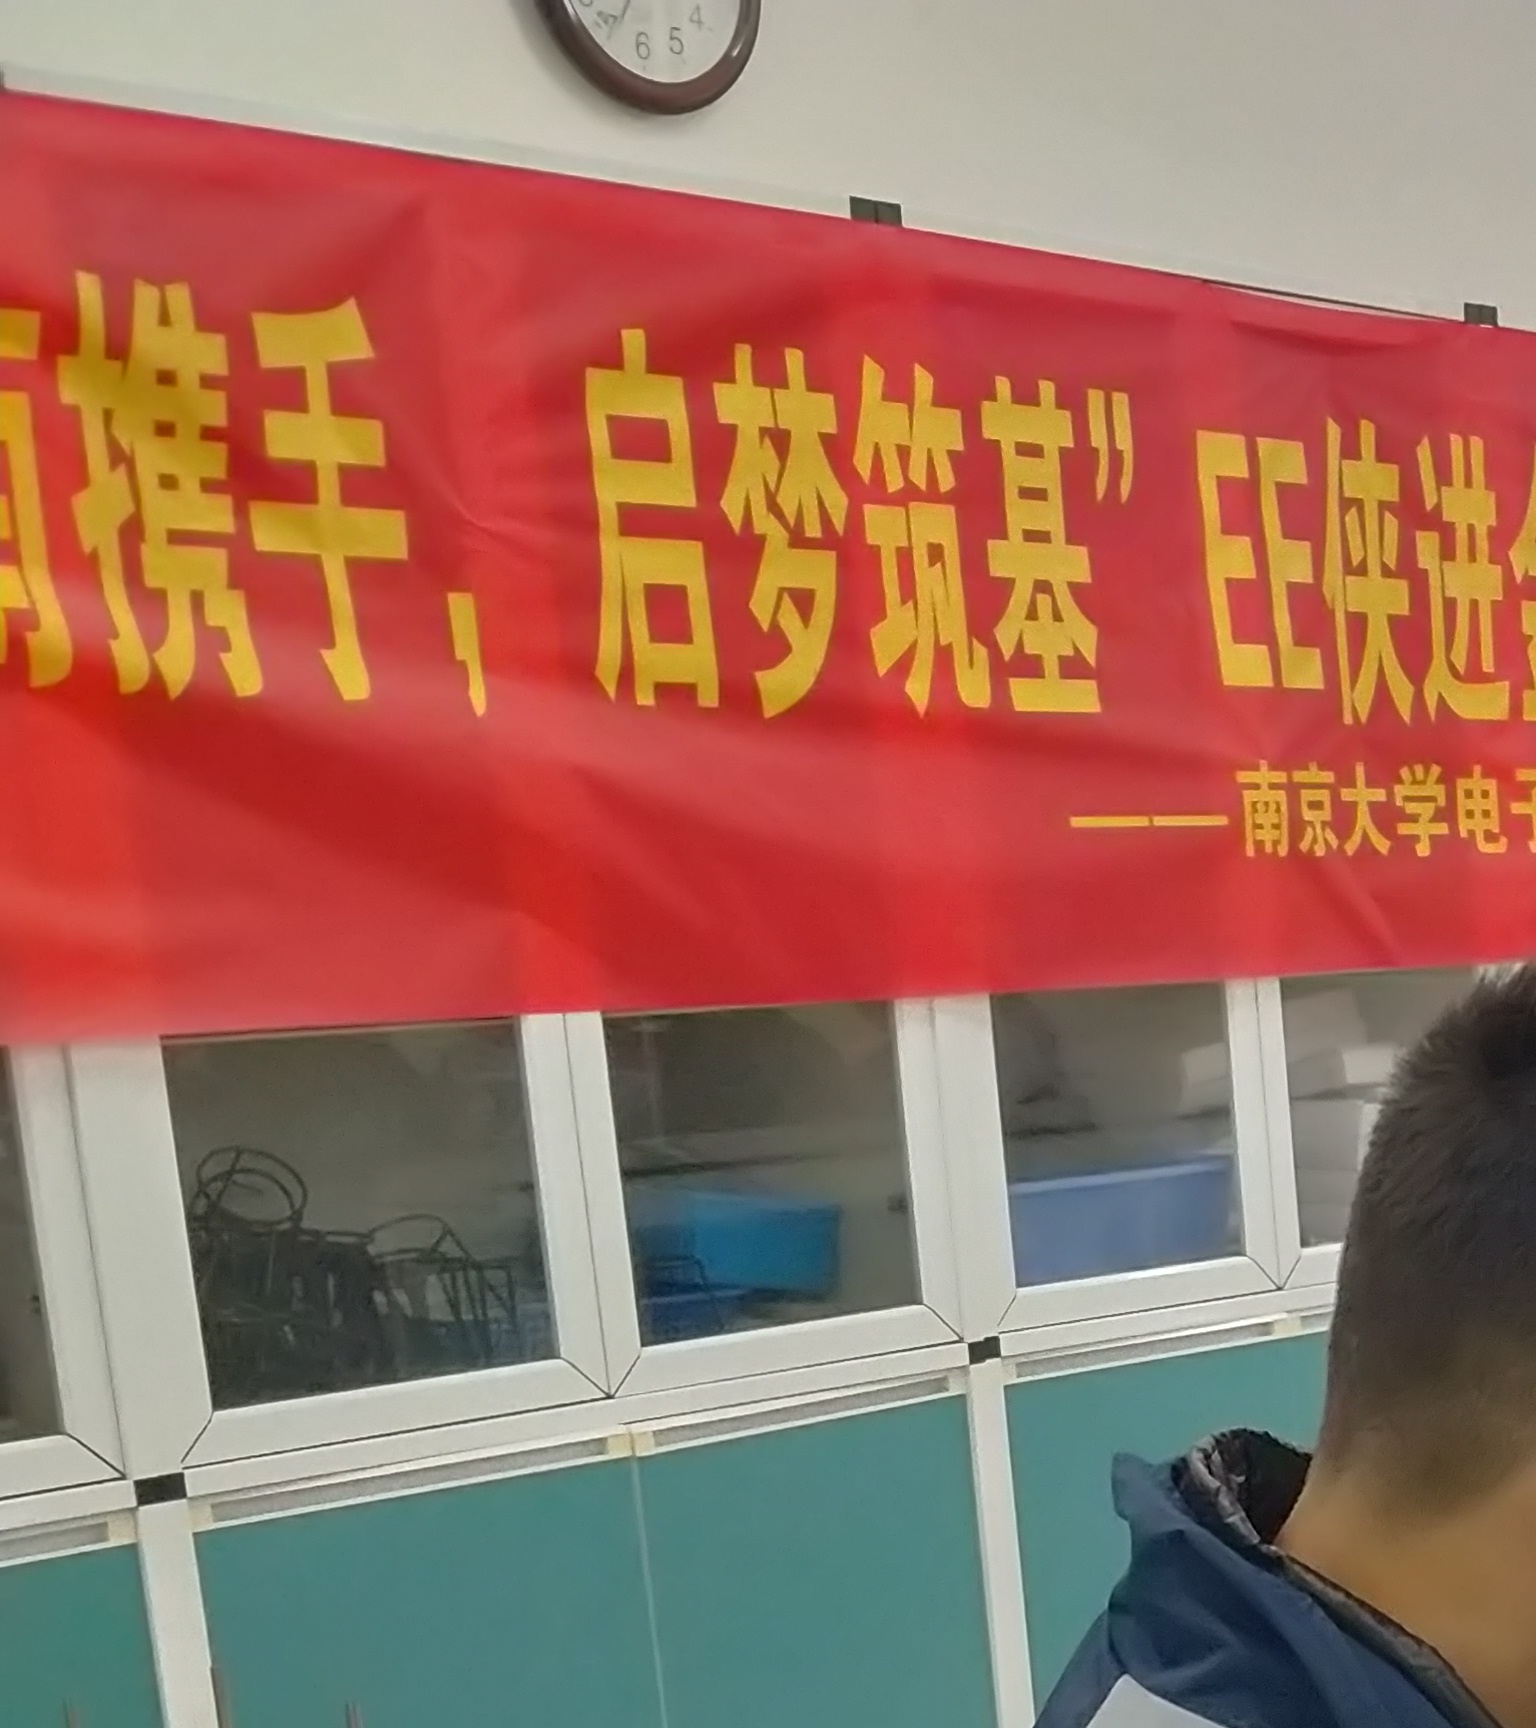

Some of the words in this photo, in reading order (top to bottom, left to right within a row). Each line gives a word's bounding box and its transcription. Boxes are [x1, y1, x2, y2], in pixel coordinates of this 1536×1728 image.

[688, 4, 704, 30] 4
[636, 32, 650, 60] 6
[669, 26, 684, 55] 5
